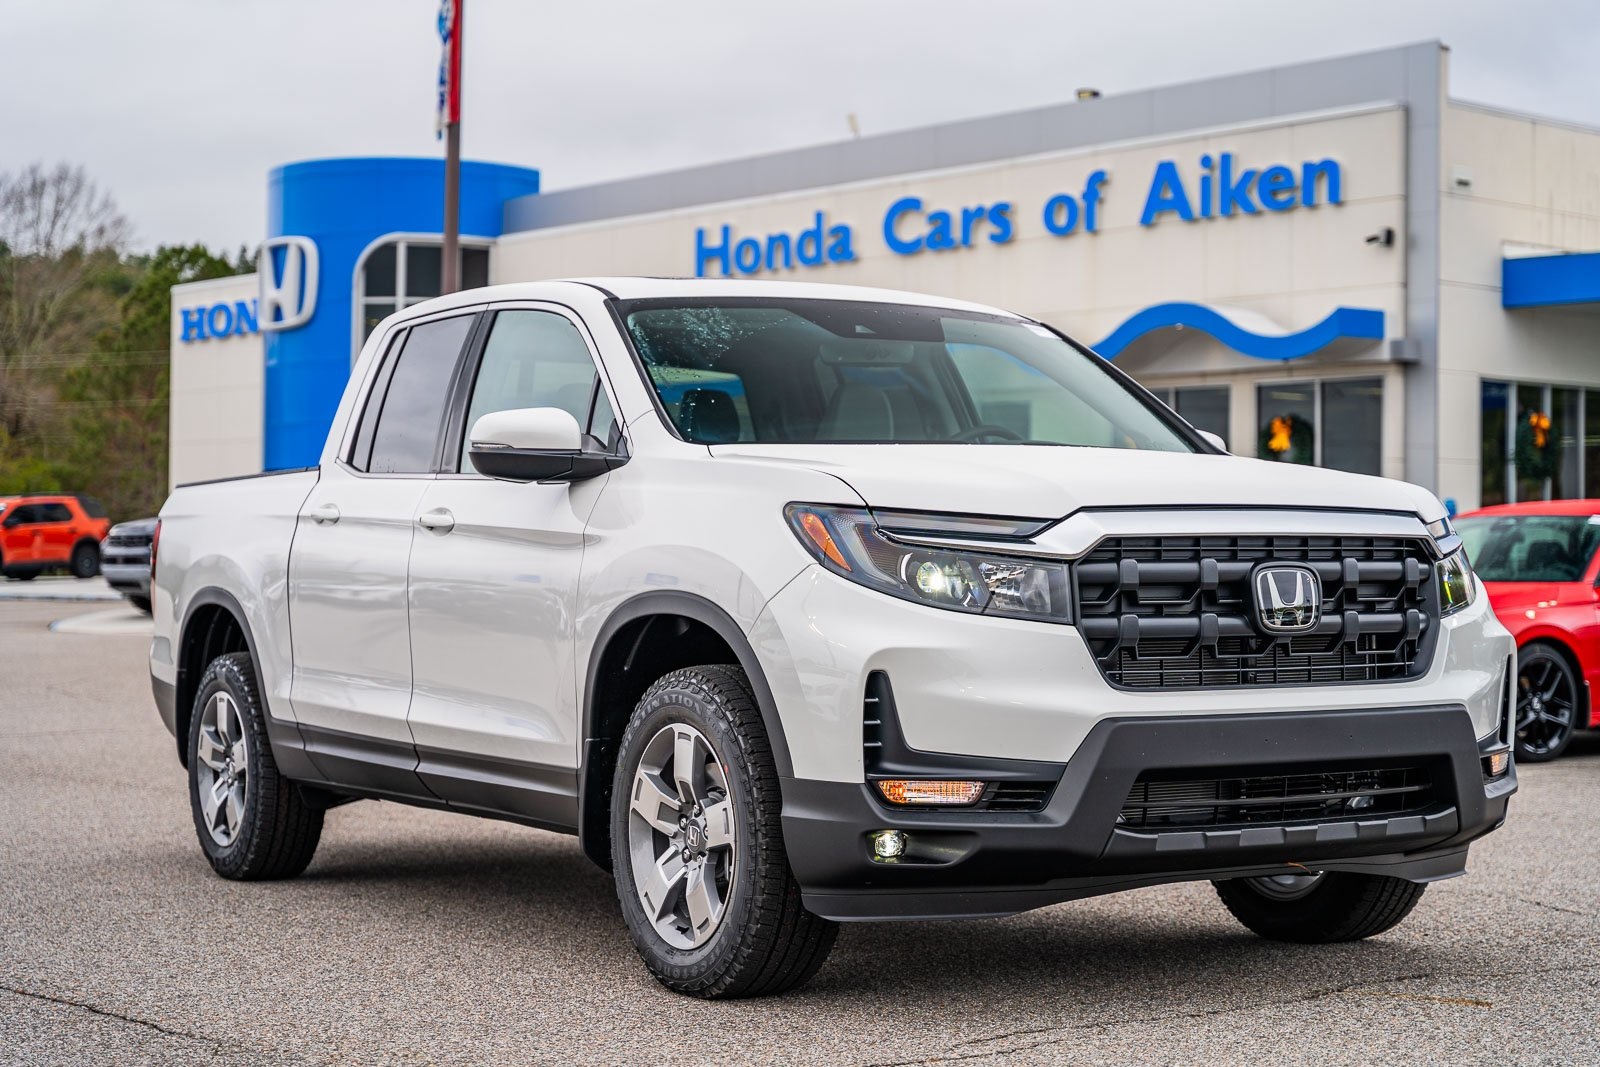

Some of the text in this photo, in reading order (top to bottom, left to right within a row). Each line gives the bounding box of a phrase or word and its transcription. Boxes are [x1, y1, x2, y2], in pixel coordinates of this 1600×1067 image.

[695, 152, 1341, 278] Honda Cars of Aiken
[180, 299, 258, 342] HON
